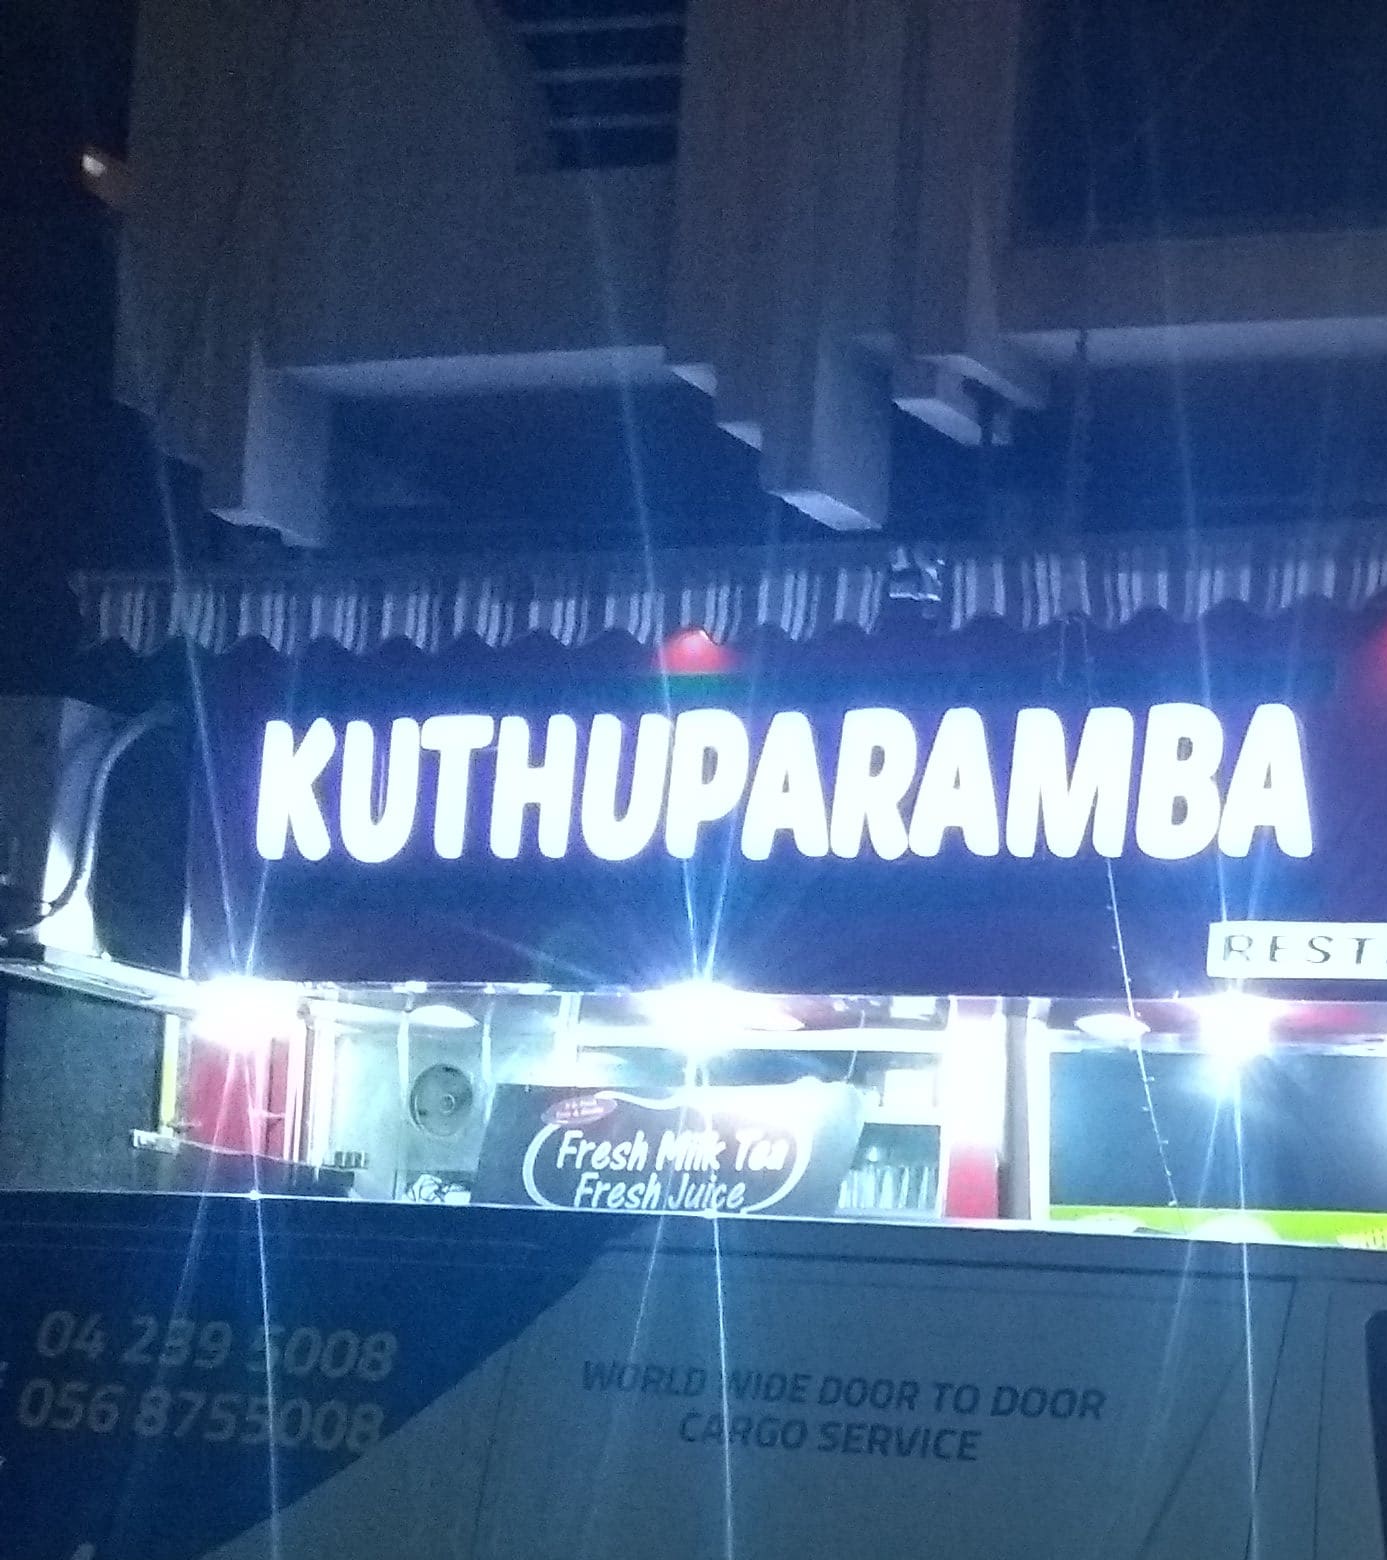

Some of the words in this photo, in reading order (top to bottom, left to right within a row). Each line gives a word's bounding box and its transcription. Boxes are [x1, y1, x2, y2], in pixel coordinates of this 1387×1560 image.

[255, 703, 1313, 863] KUTHUPARAMBA
[557, 1129, 649, 1171] Fresh
[655, 1129, 727, 1172] Milk
[734, 1131, 790, 1172] Tea
[574, 1172, 661, 1209] Fresh
[667, 1177, 746, 1211] Juice
[37, 1310, 107, 1360] 04
[119, 1313, 234, 1370] 239
[247, 1322, 400, 1383] 5008
[17, 1377, 128, 1435] 056
[132, 1384, 386, 1455] 8755008
[581, 1359, 705, 1398] WORLD
[718, 1367, 812, 1406] WIDE
[817, 1374, 919, 1414] DOOR
[934, 1381, 980, 1417] TO
[990, 1384, 1108, 1422] DOOR
[678, 1411, 808, 1453] CARGO
[817, 1420, 983, 1463] SERVICE
